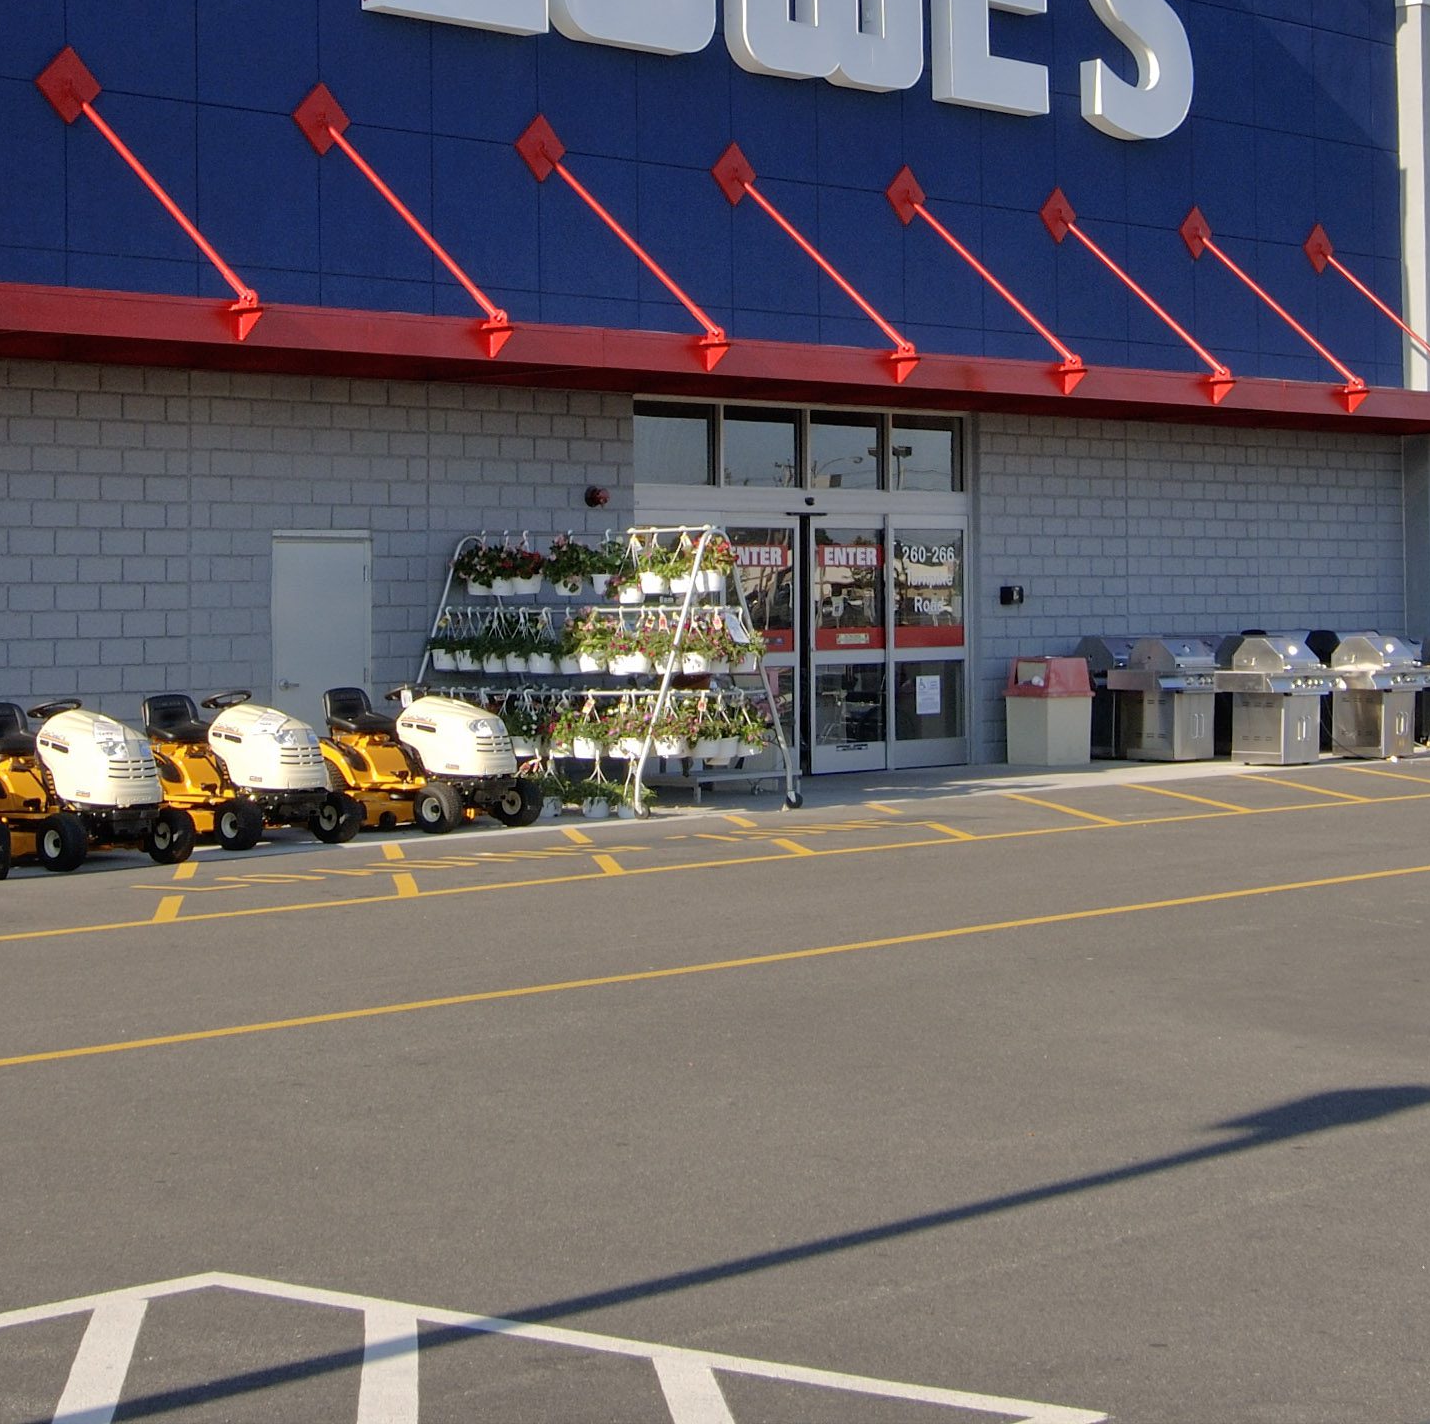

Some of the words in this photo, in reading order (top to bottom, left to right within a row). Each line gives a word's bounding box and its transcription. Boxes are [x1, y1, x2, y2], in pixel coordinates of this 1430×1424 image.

[824, 546, 877, 566] ENTER
[902, 546, 955, 564] 260-266
[914, 595, 946, 613] Road
